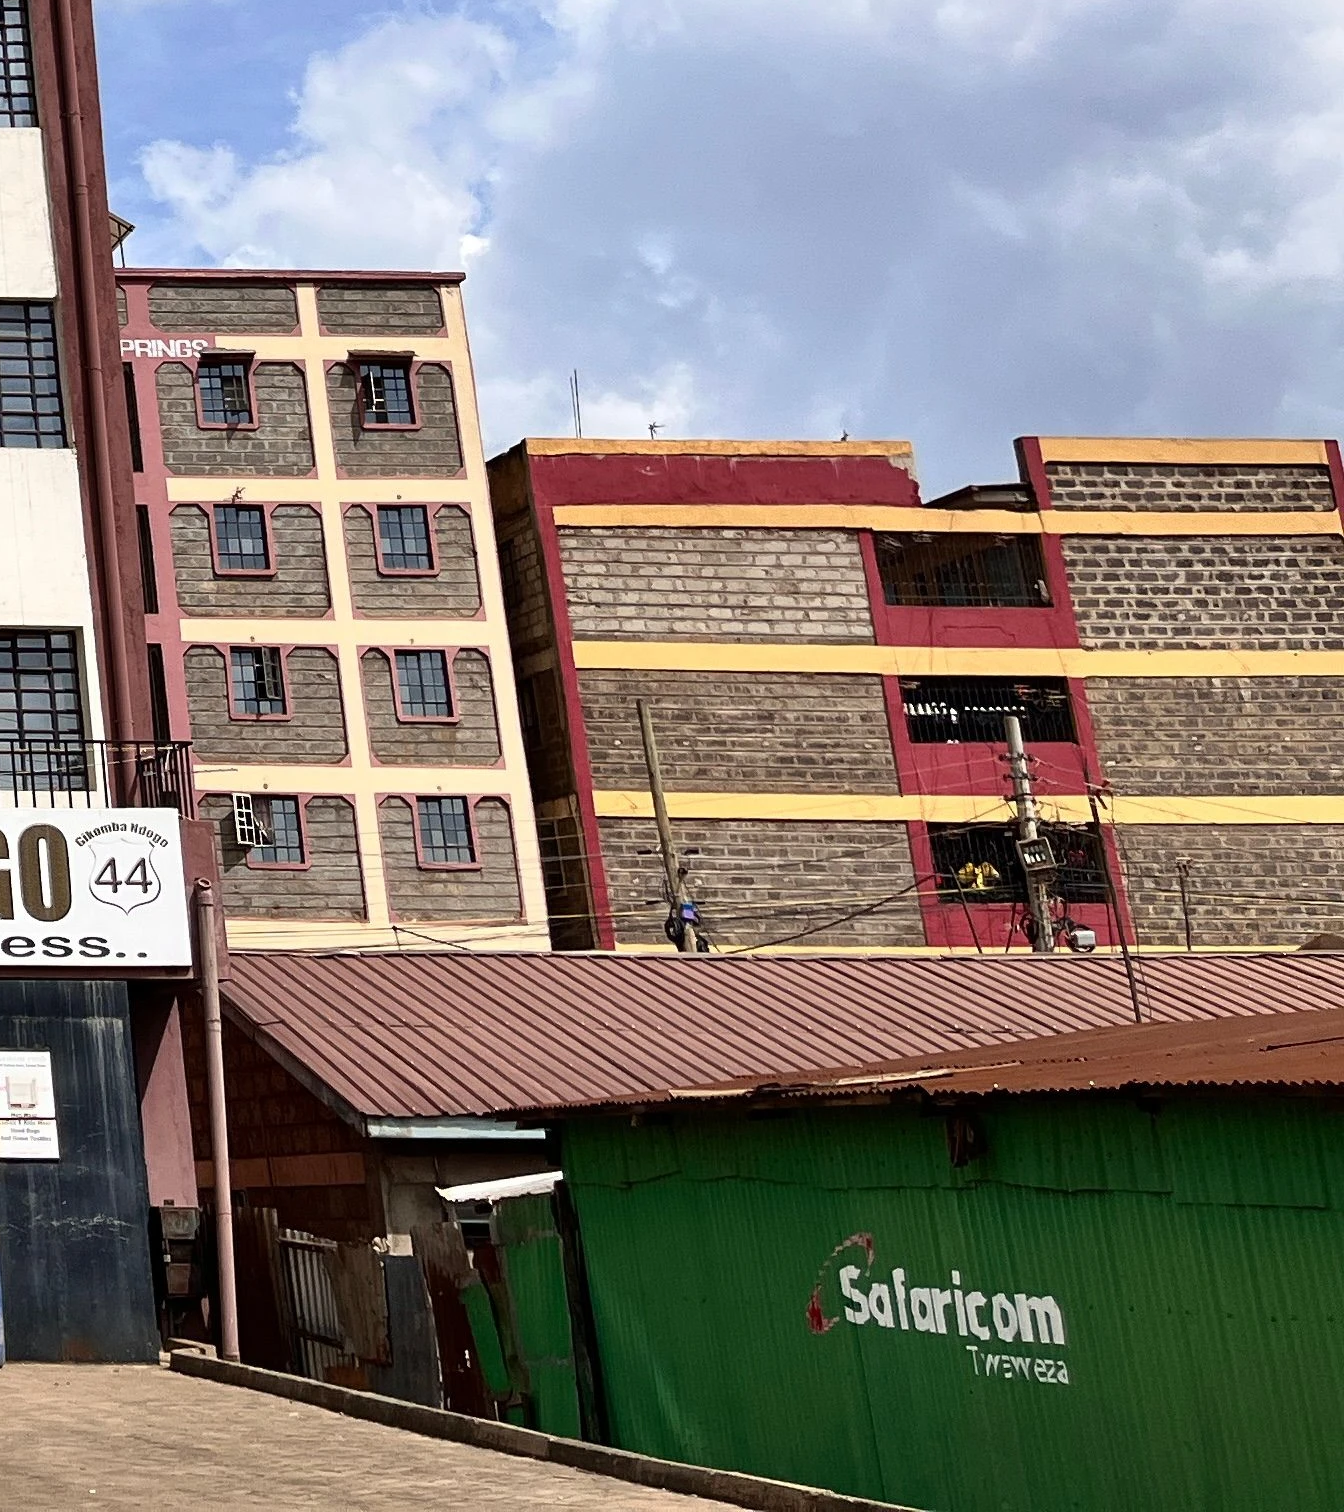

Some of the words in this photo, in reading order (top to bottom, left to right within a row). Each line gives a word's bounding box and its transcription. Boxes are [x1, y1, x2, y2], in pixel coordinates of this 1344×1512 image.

[119, 339, 209, 358] PRINGS
[75, 822, 127, 847] Gikomba
[131, 822, 169, 848] Ndogo
[95, 857, 153, 894] 44
[839, 1264, 1065, 1345] Safaricom
